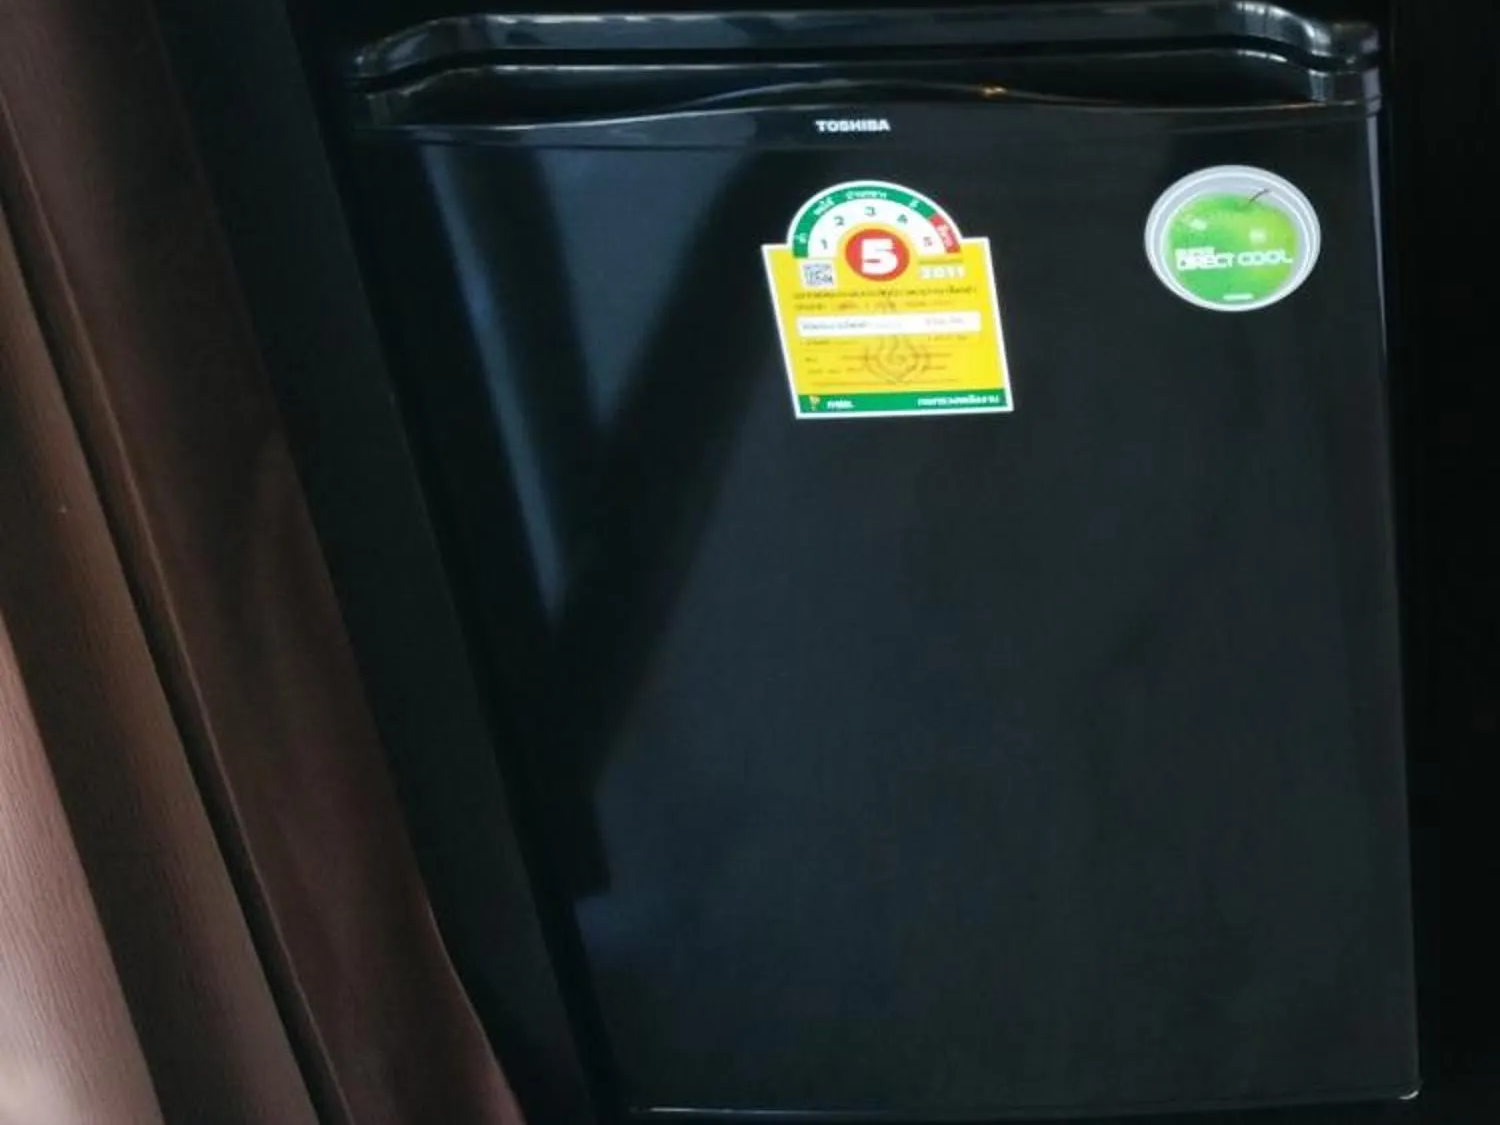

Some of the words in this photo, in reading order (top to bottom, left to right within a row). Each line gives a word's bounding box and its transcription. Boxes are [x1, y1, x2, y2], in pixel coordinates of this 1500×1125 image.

[815, 119, 891, 132] TOSHIBA
[833, 215, 845, 227] 2
[864, 206, 877, 217] 3
[861, 238, 900, 275] 5
[1237, 249, 1293, 266] COOL
